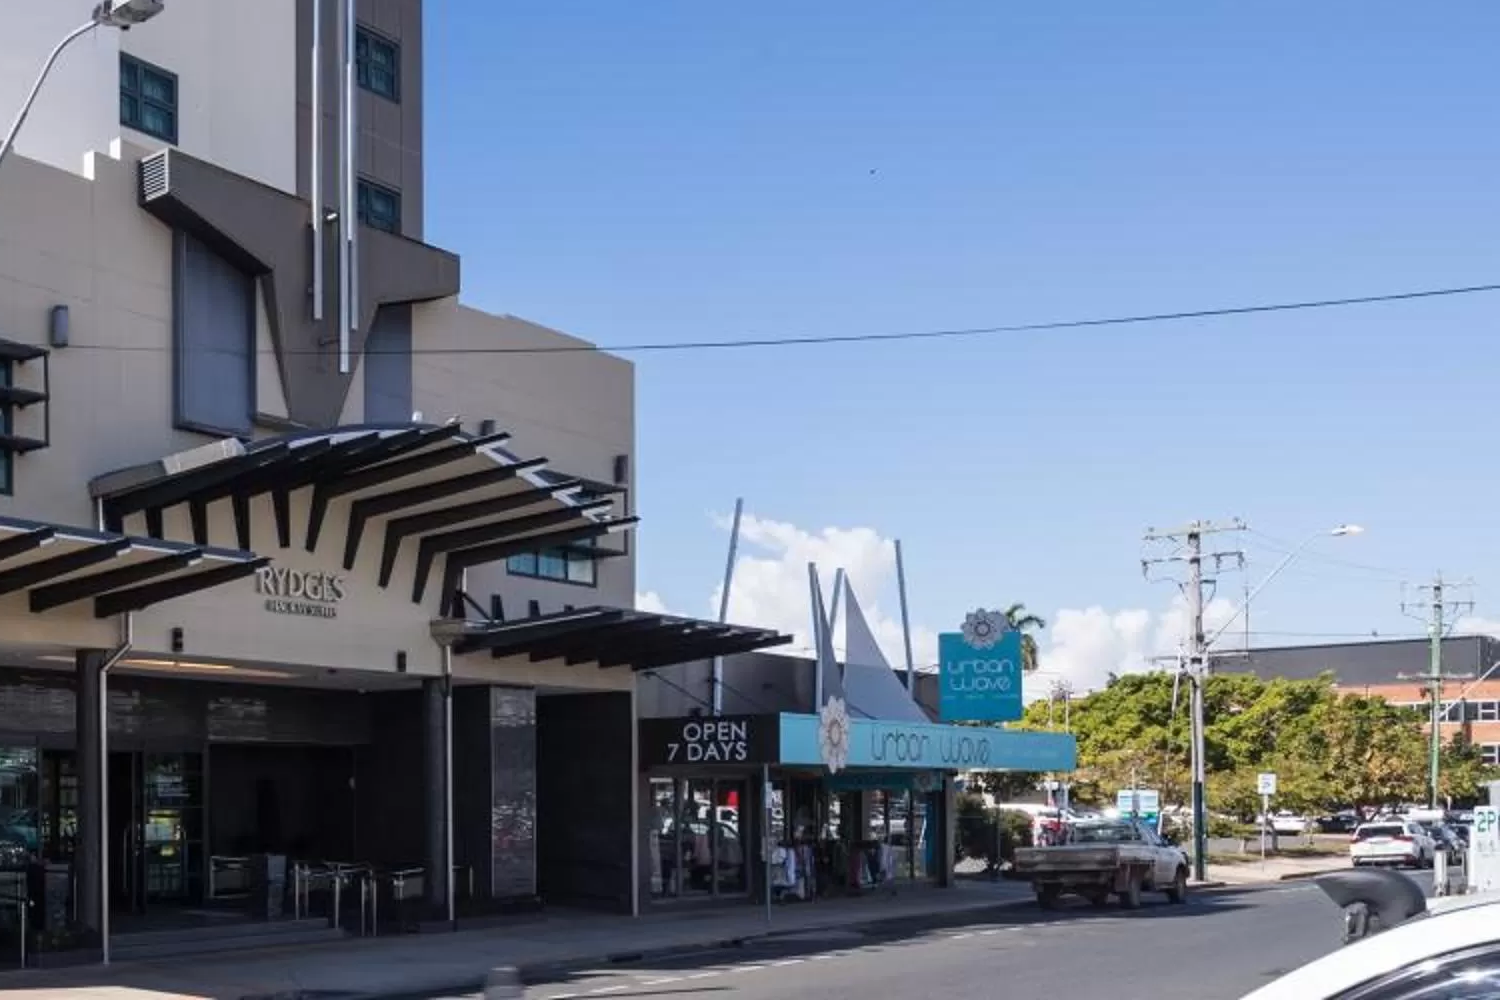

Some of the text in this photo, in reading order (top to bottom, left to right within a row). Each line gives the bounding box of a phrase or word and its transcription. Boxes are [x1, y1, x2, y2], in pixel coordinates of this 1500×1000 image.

[258, 567, 347, 601] RYDGES
[947, 659, 1015, 674] urban
[950, 676, 1012, 692] wave
[683, 721, 747, 741] OPEN
[667, 741, 747, 761] 7 DAYS
[871, 728, 930, 762] urban
[939, 733, 993, 766] wave
[1477, 810, 1497, 833] 2P
